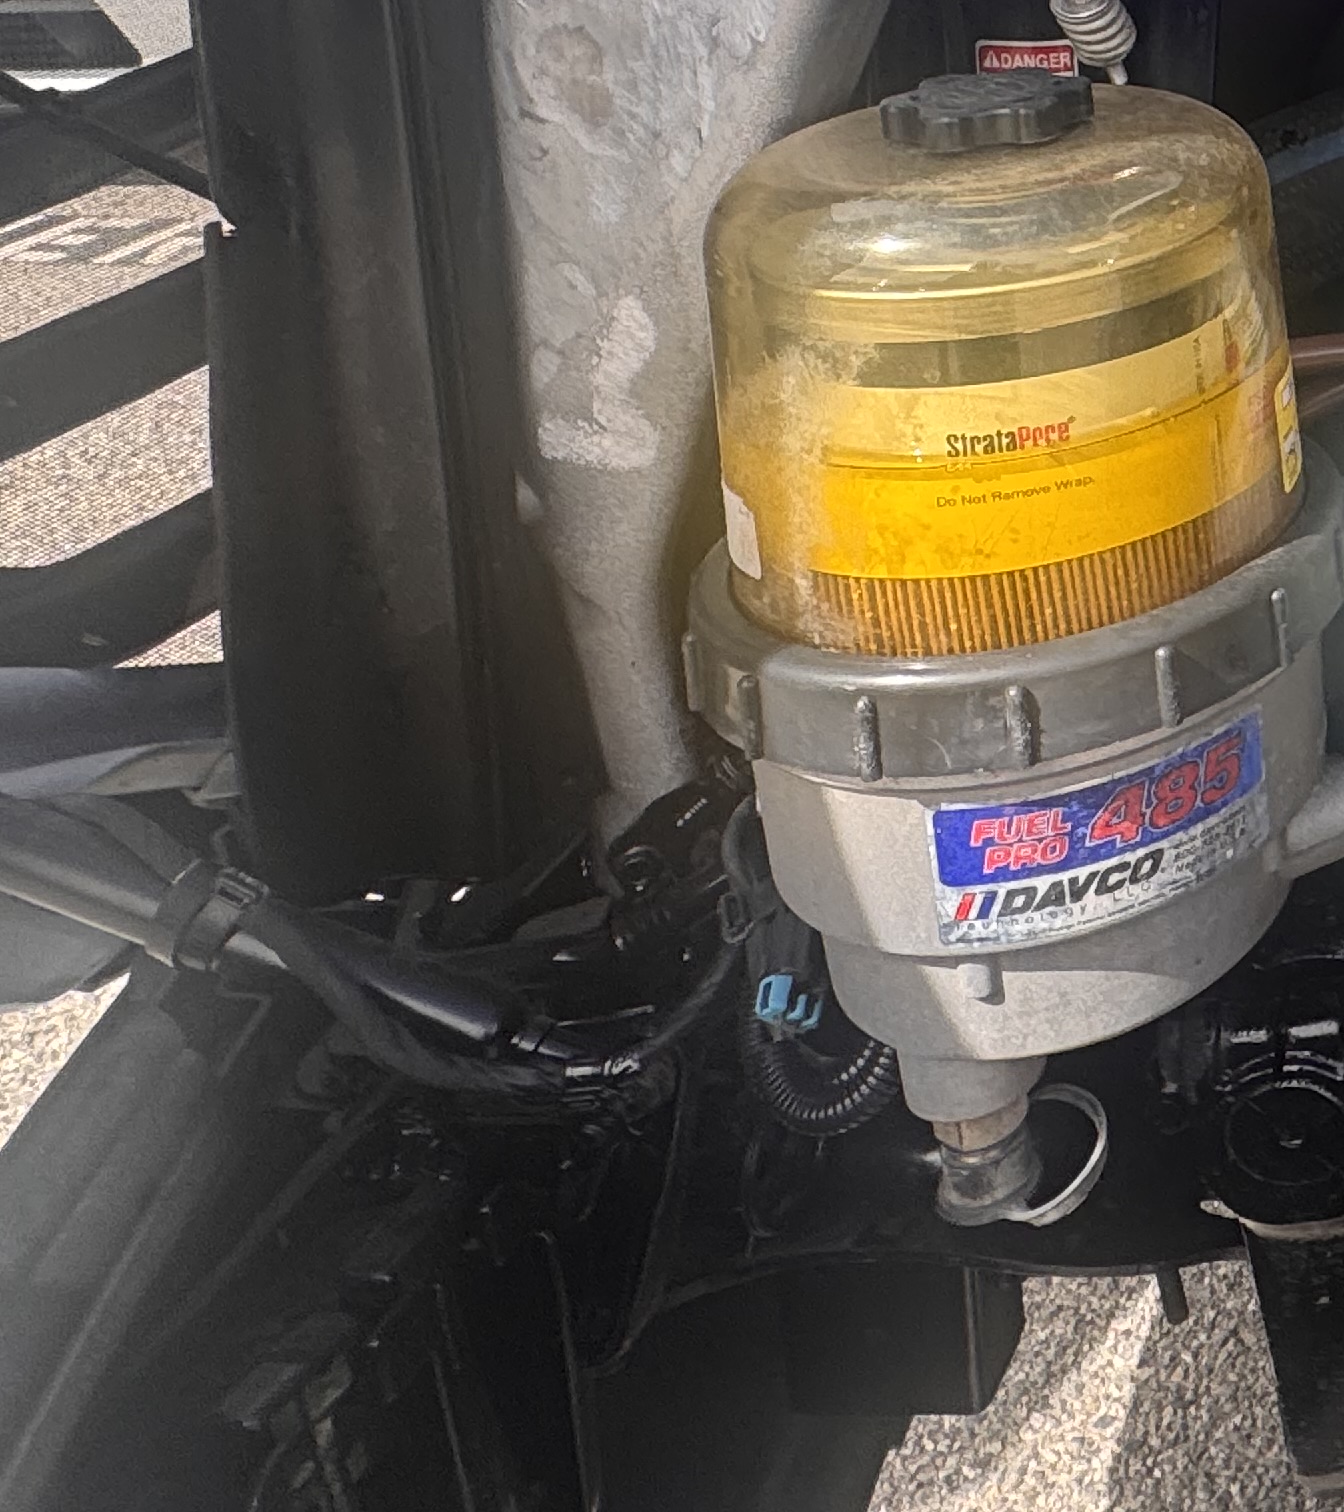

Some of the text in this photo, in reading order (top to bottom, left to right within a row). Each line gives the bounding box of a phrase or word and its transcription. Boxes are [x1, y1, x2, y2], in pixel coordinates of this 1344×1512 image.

[1001, 53, 1071, 69] DANGER
[936, 496, 957, 507] Do
[961, 494, 988, 506] Not
[991, 486, 1050, 502] Remove
[1085, 731, 1246, 848] 485
[970, 808, 1072, 847] FUEL
[983, 833, 1069, 875] PRO
[997, 848, 1165, 917] DAVCO
